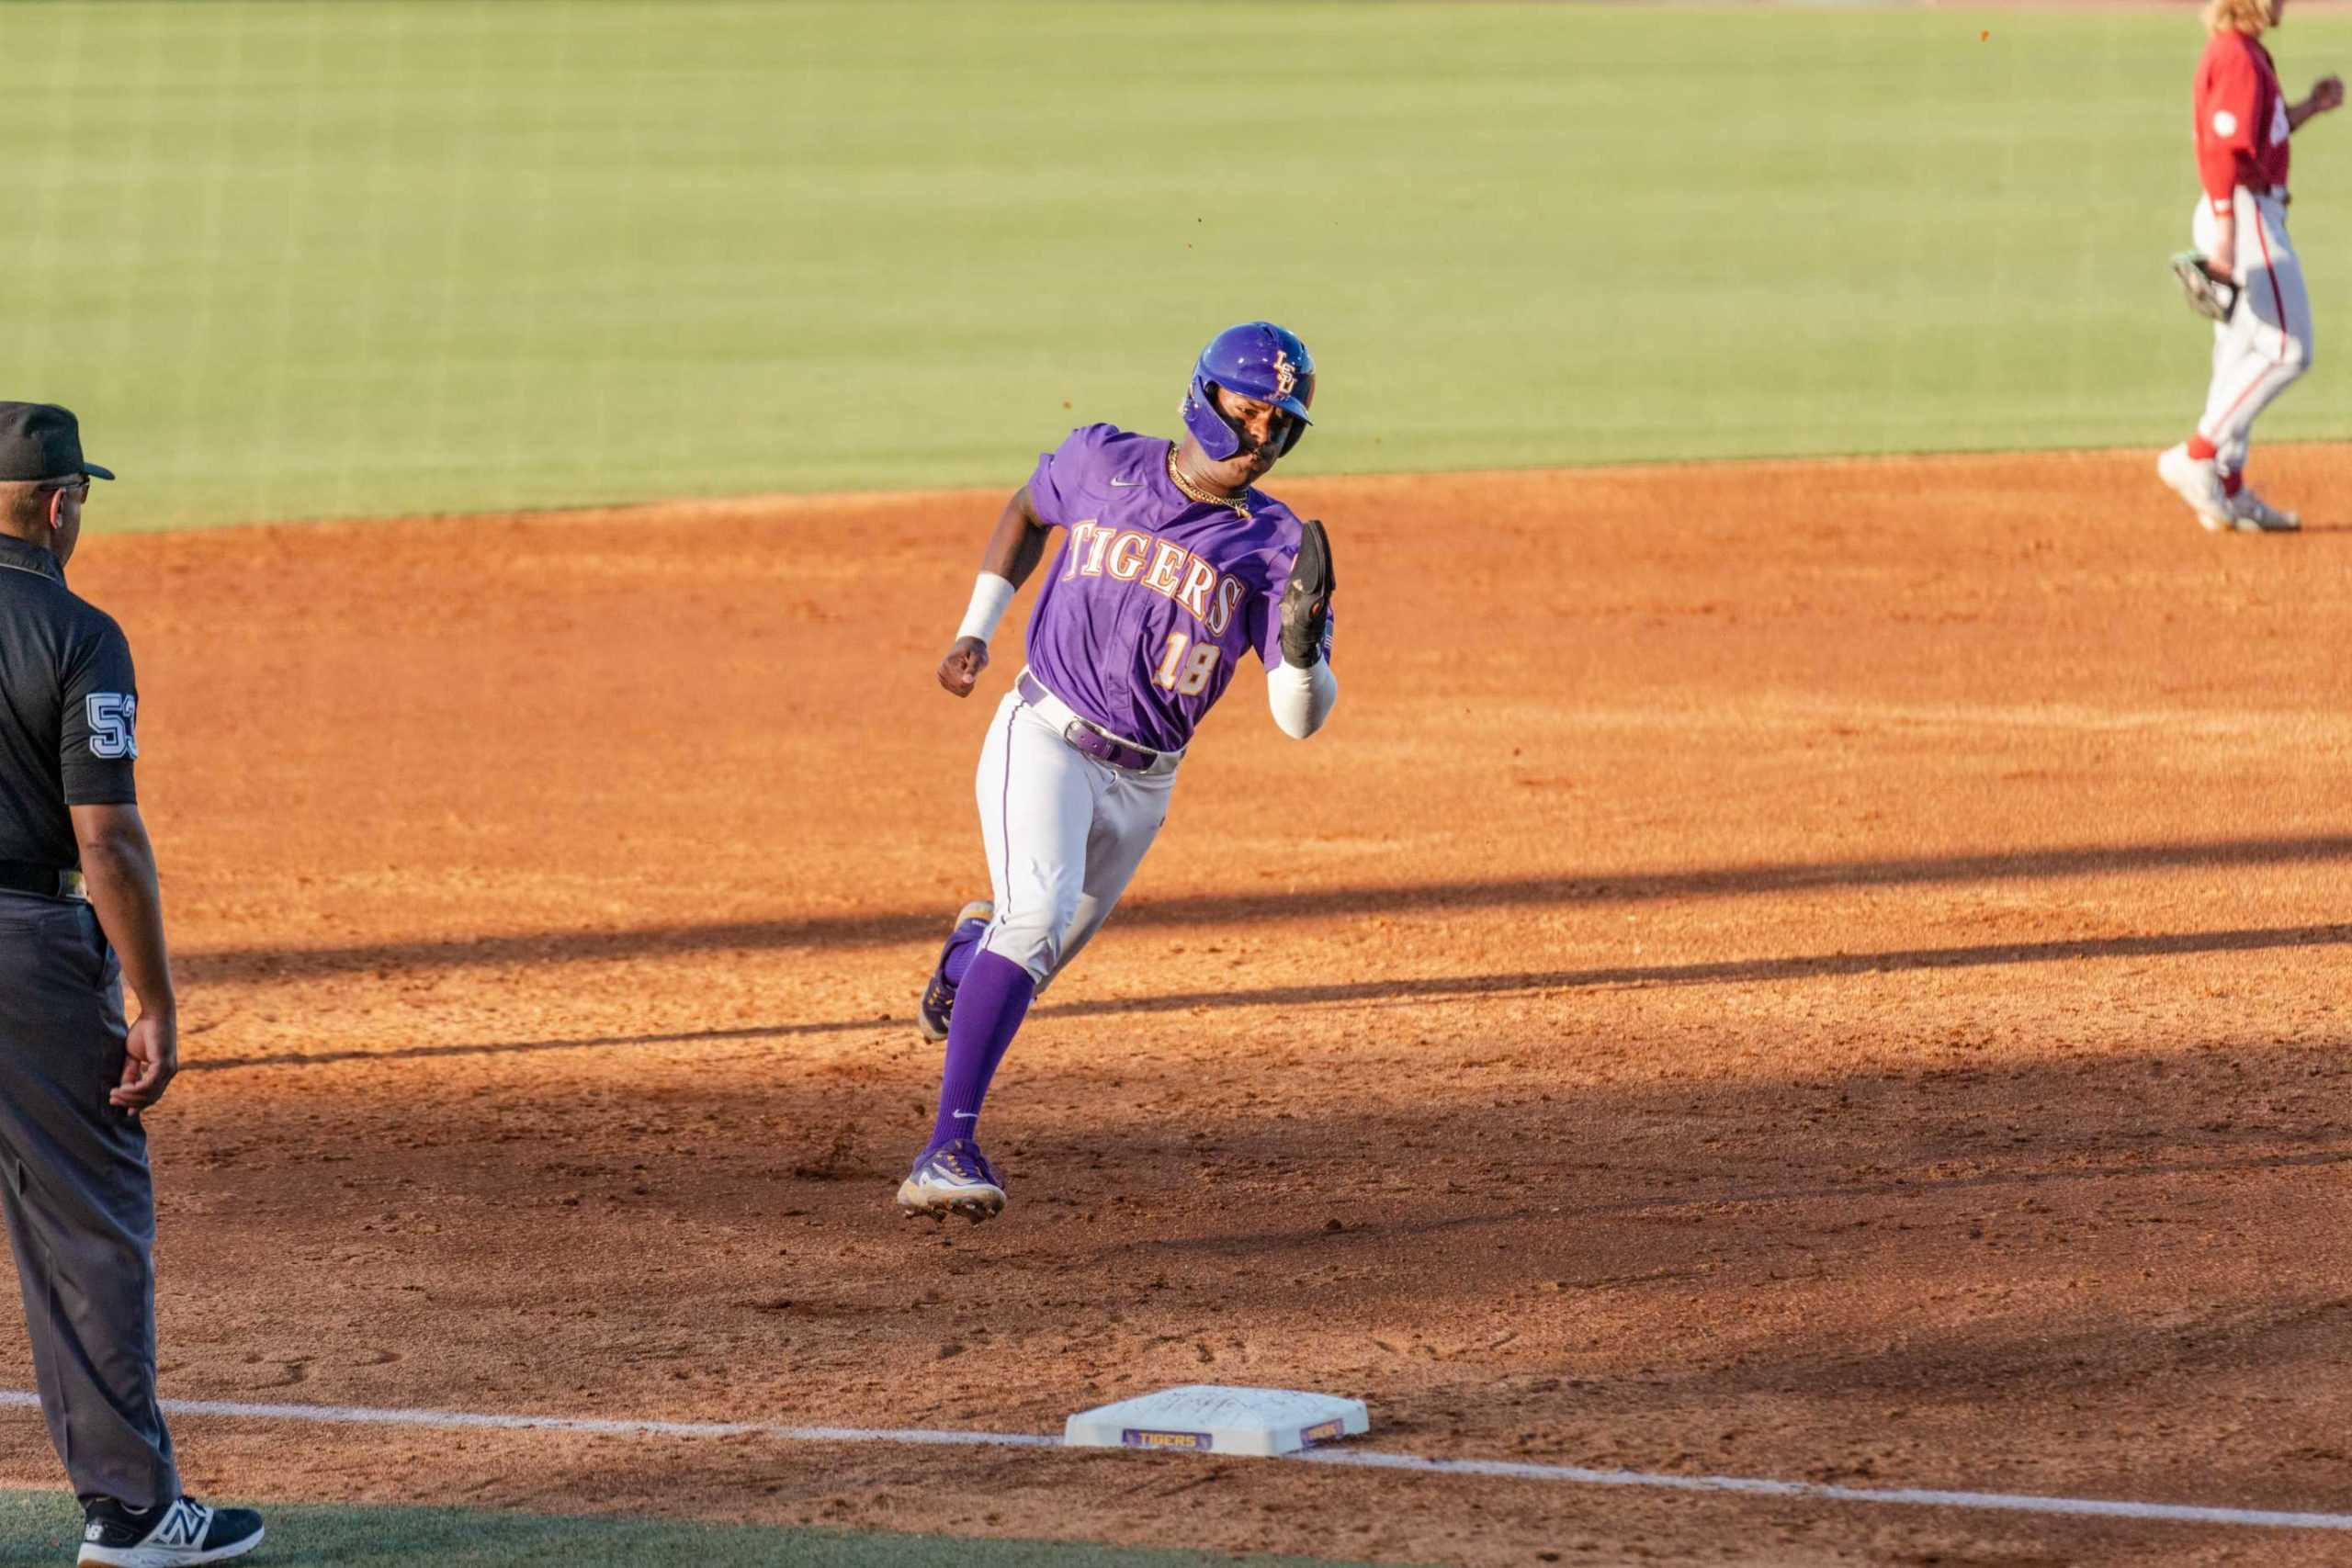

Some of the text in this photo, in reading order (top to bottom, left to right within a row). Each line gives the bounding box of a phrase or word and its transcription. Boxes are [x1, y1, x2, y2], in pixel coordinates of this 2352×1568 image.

[1062, 518, 1245, 637] TIGERS
[1152, 631, 1220, 696] 18
[1139, 1433, 1196, 1448] TIGERS
